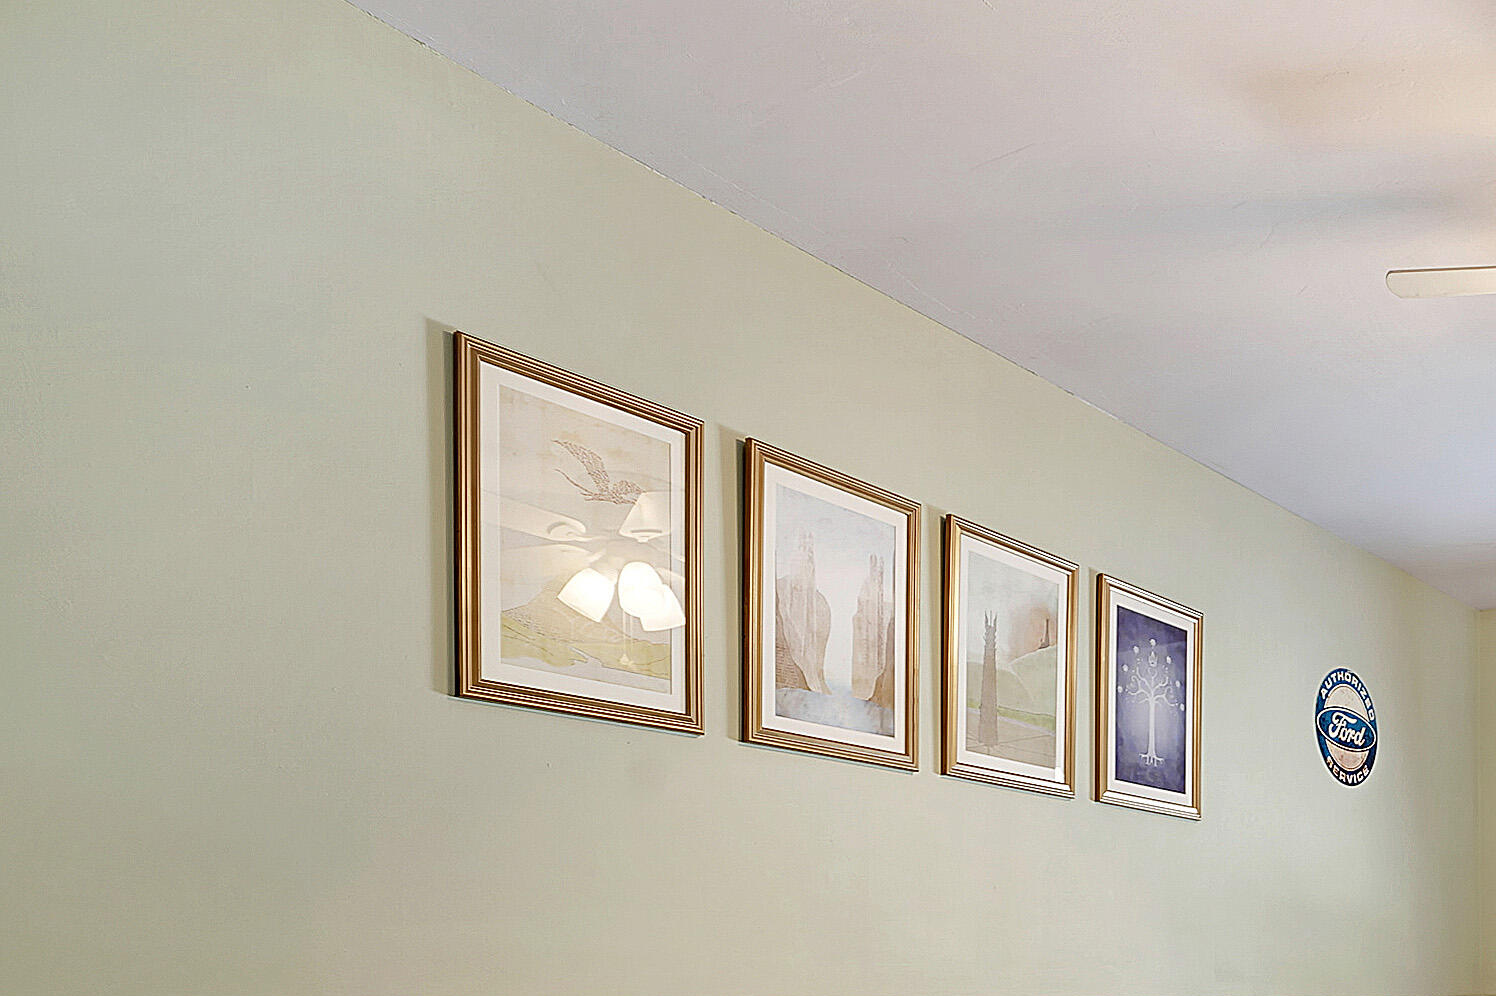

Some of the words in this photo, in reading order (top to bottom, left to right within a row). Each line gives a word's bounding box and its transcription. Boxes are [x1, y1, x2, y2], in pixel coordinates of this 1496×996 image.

[1320, 670, 1375, 721] AUTHORIZED
[1328, 712, 1367, 747] Ford
[1326, 756, 1370, 784] SERVICE
